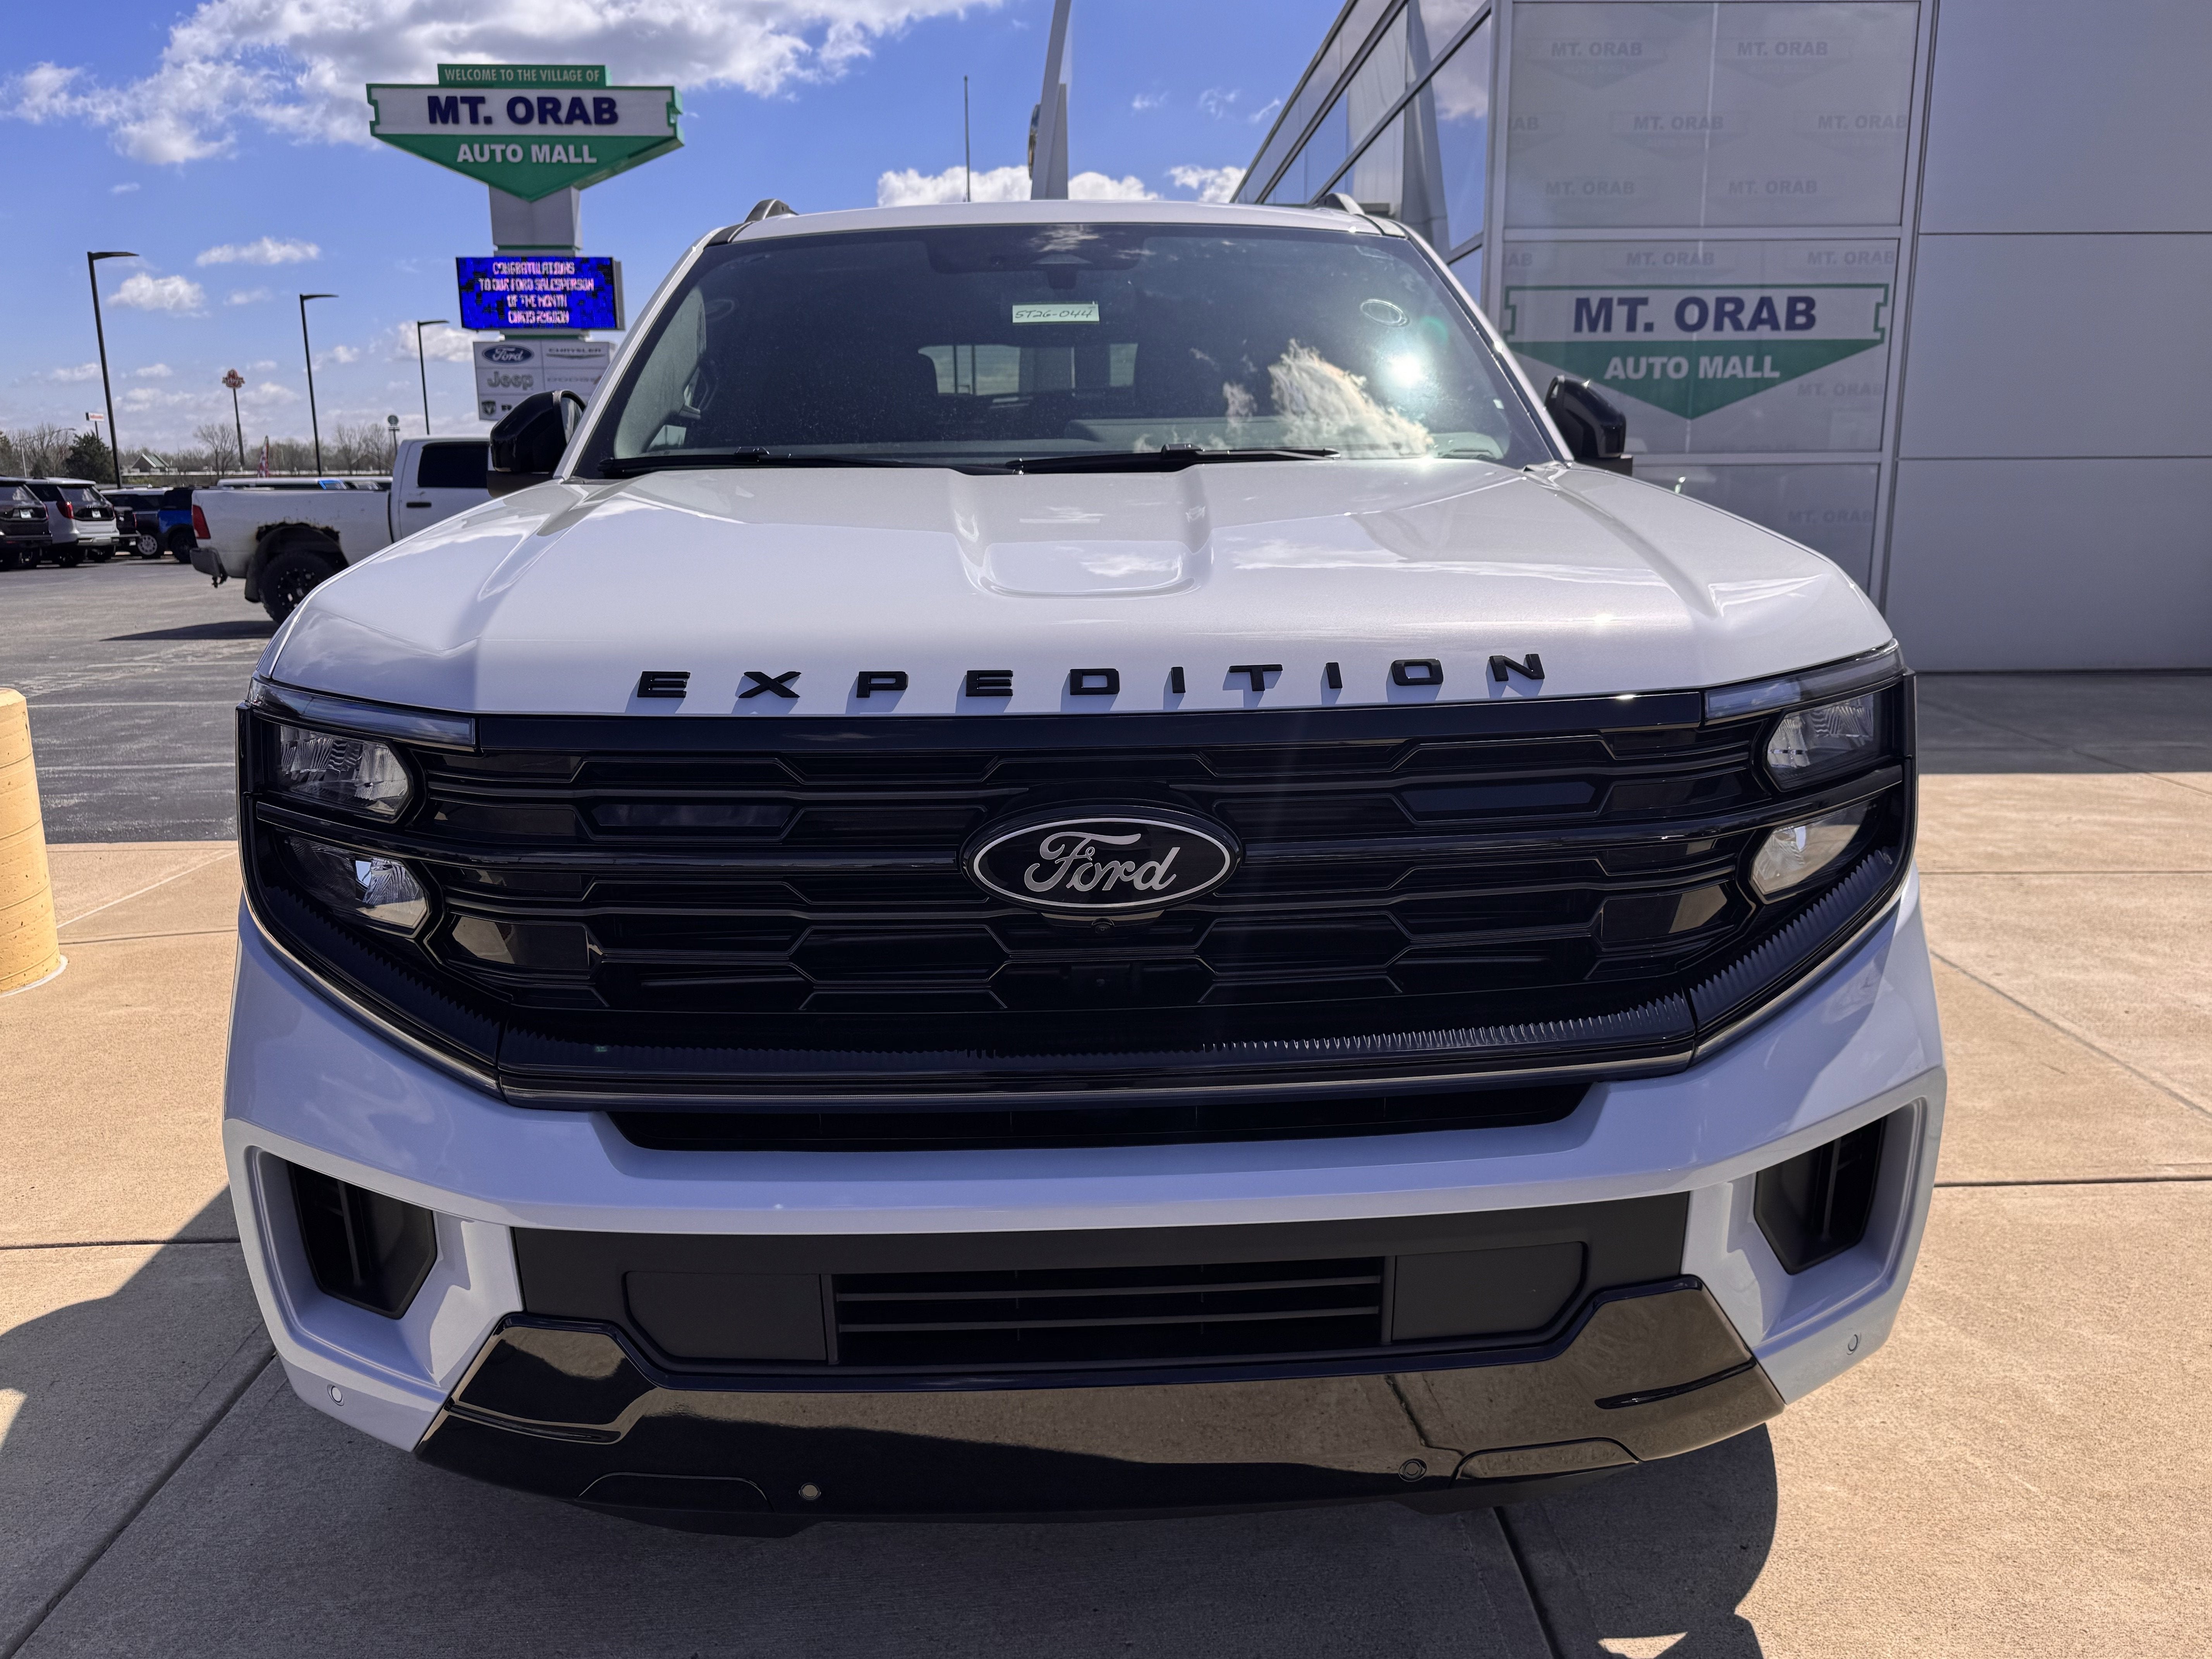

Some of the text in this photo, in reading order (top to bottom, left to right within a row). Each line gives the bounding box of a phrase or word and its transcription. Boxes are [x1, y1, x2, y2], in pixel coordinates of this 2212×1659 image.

[1551, 42, 1642, 56] MT. ORAB
[1737, 41, 1828, 56] MT. ORAB
[444, 69, 599, 82] WELCOME TO THE VILLAGE OF
[427, 96, 618, 125] MT. ORAB
[1671, 117, 1723, 130] ORAB
[1855, 115, 1908, 129] ORAB
[457, 144, 597, 163] AUTO MALL
[1582, 181, 1634, 194] ORAB
[1765, 180, 1817, 194] ORAB
[1662, 252, 1714, 266] ORAB
[1844, 251, 1895, 264] ORAB
[1574, 296, 1816, 332] MT. ORAB
[492, 348, 523, 361] Ford
[1604, 356, 1780, 379] AUTO MALL
[487, 371, 534, 391] Jeep
[637, 653, 1545, 699] EXPEDITION
[1024, 831, 1181, 891] Ford
